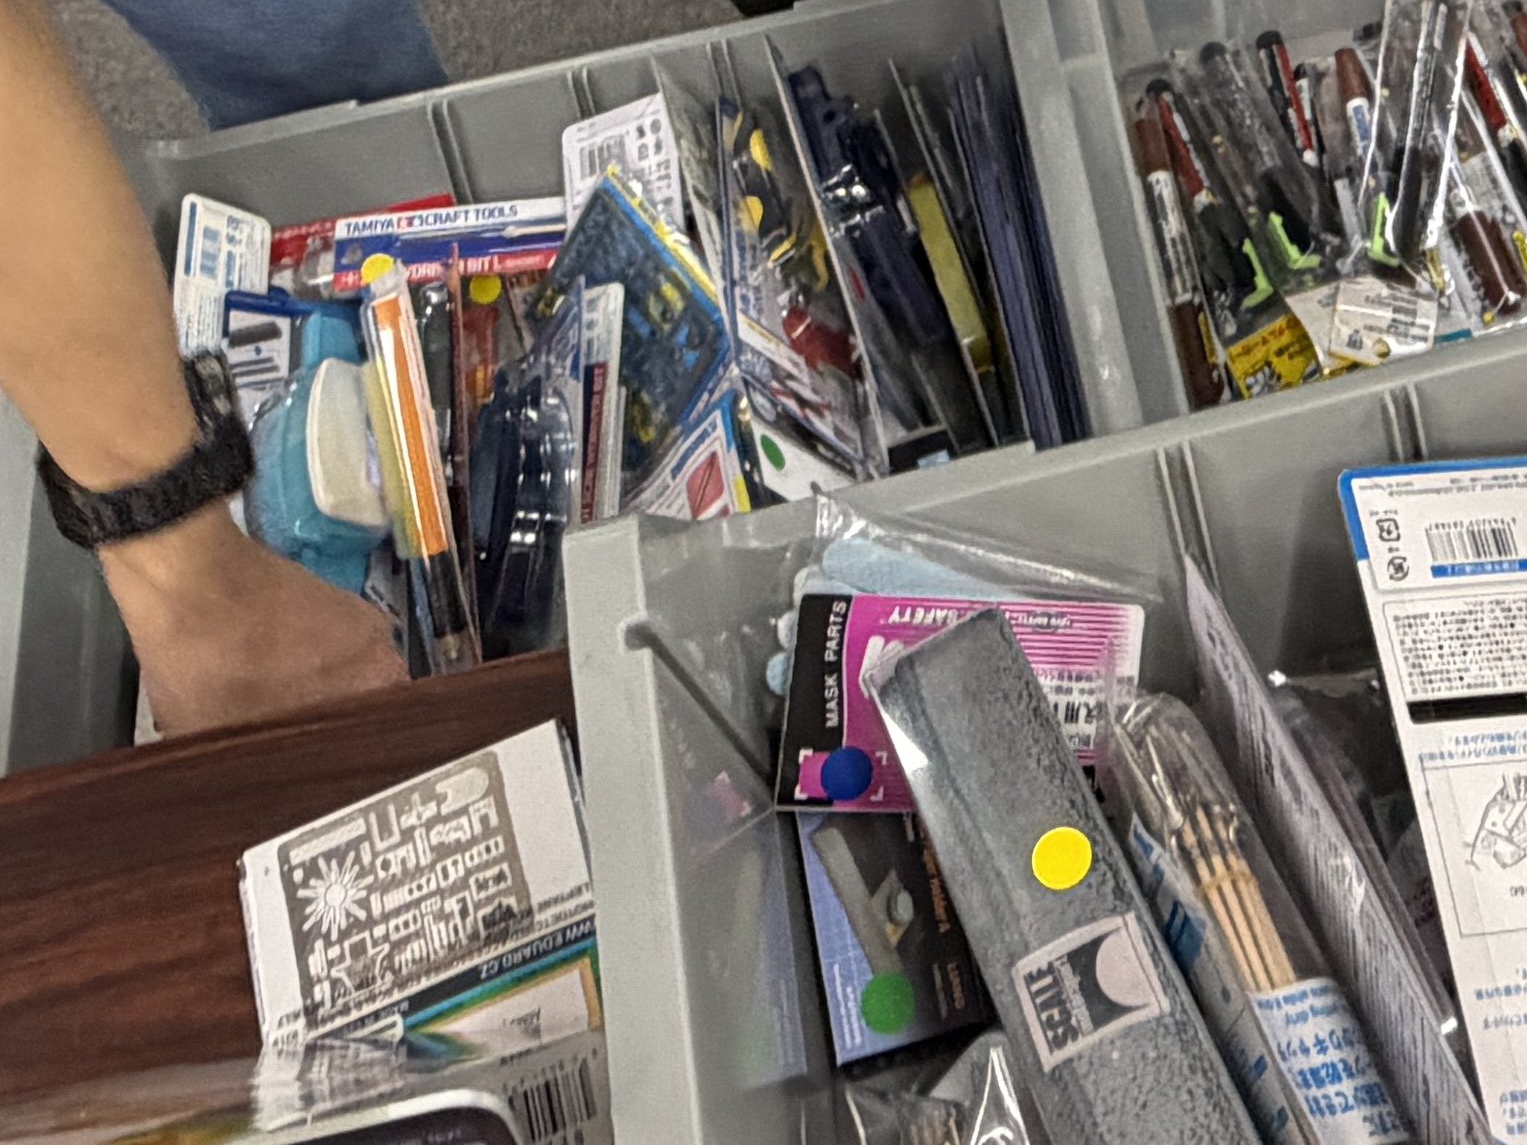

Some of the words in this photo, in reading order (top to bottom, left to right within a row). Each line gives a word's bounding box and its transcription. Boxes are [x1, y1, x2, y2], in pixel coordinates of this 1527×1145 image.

[345, 220, 395, 236] TAMIYA
[475, 205, 518, 220] TOOLS
[825, 601, 847, 662] PARTS
[825, 678, 841, 728] MASK
